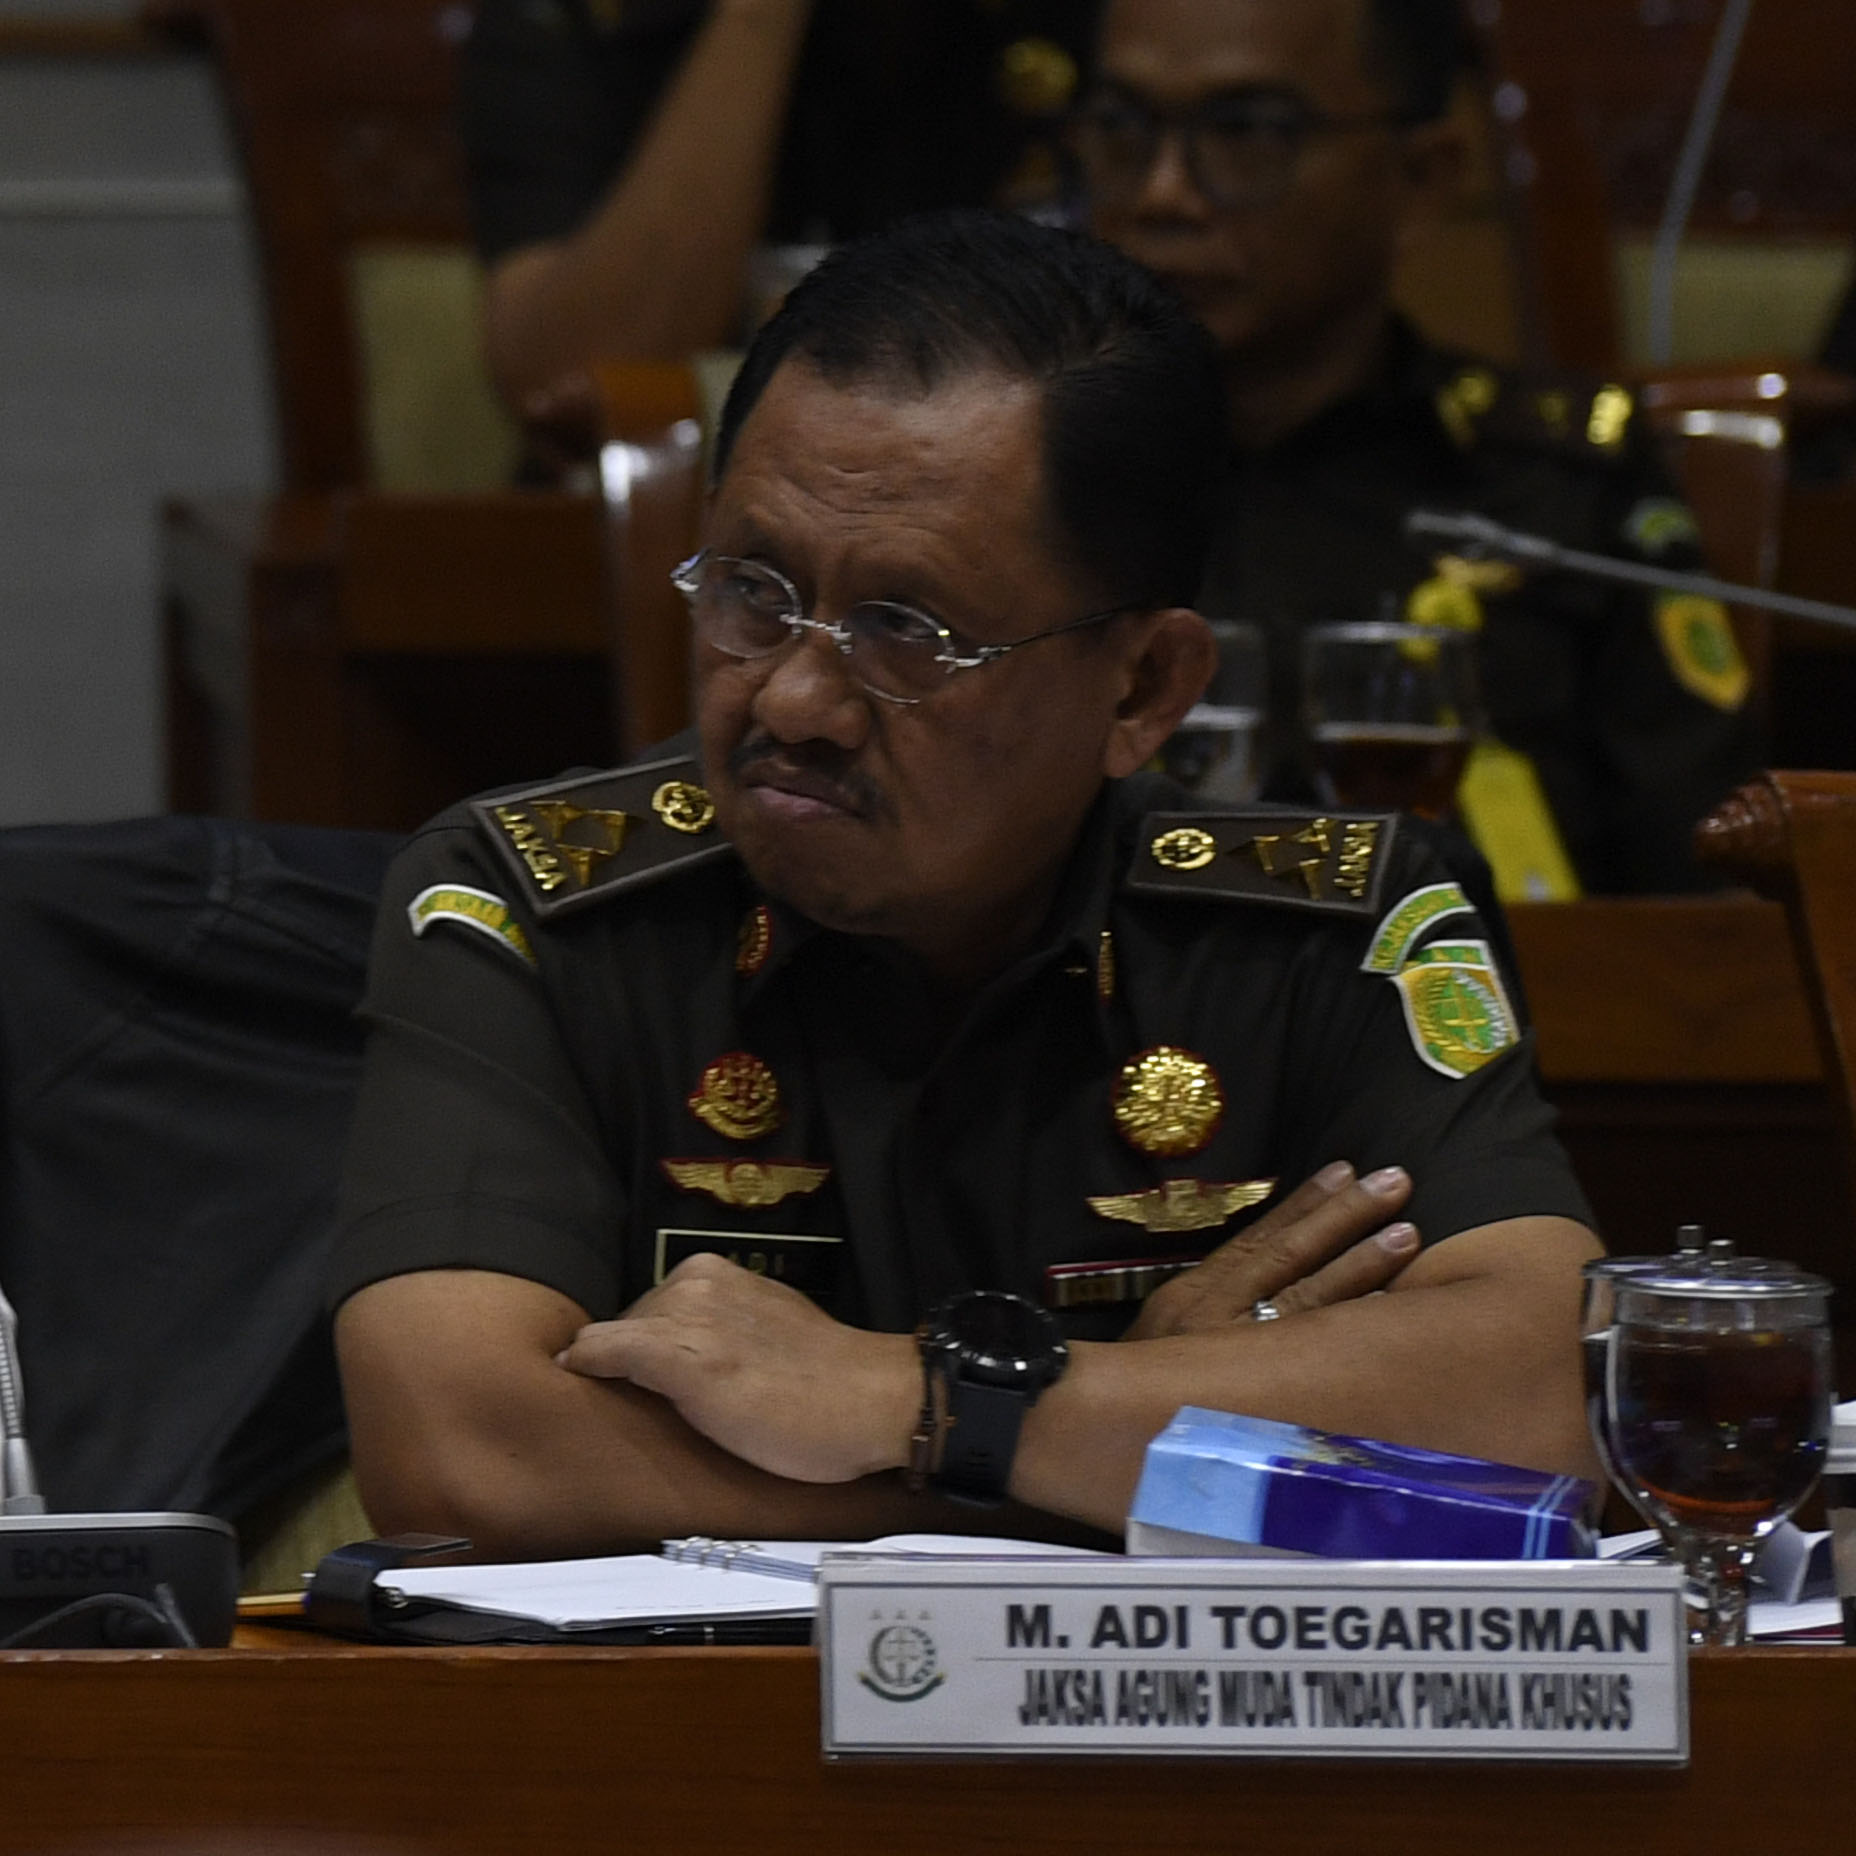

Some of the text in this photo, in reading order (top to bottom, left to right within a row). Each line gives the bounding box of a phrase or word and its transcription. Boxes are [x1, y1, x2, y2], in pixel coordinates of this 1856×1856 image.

[12, 1545, 150, 1582] BOSCH
[1006, 1604, 1649, 1653] M. ADI TOEGARISMAN
[1017, 1668, 1633, 1732] JAKSA AGUNG MUDA TINDAK PIDANA KHUSUS
